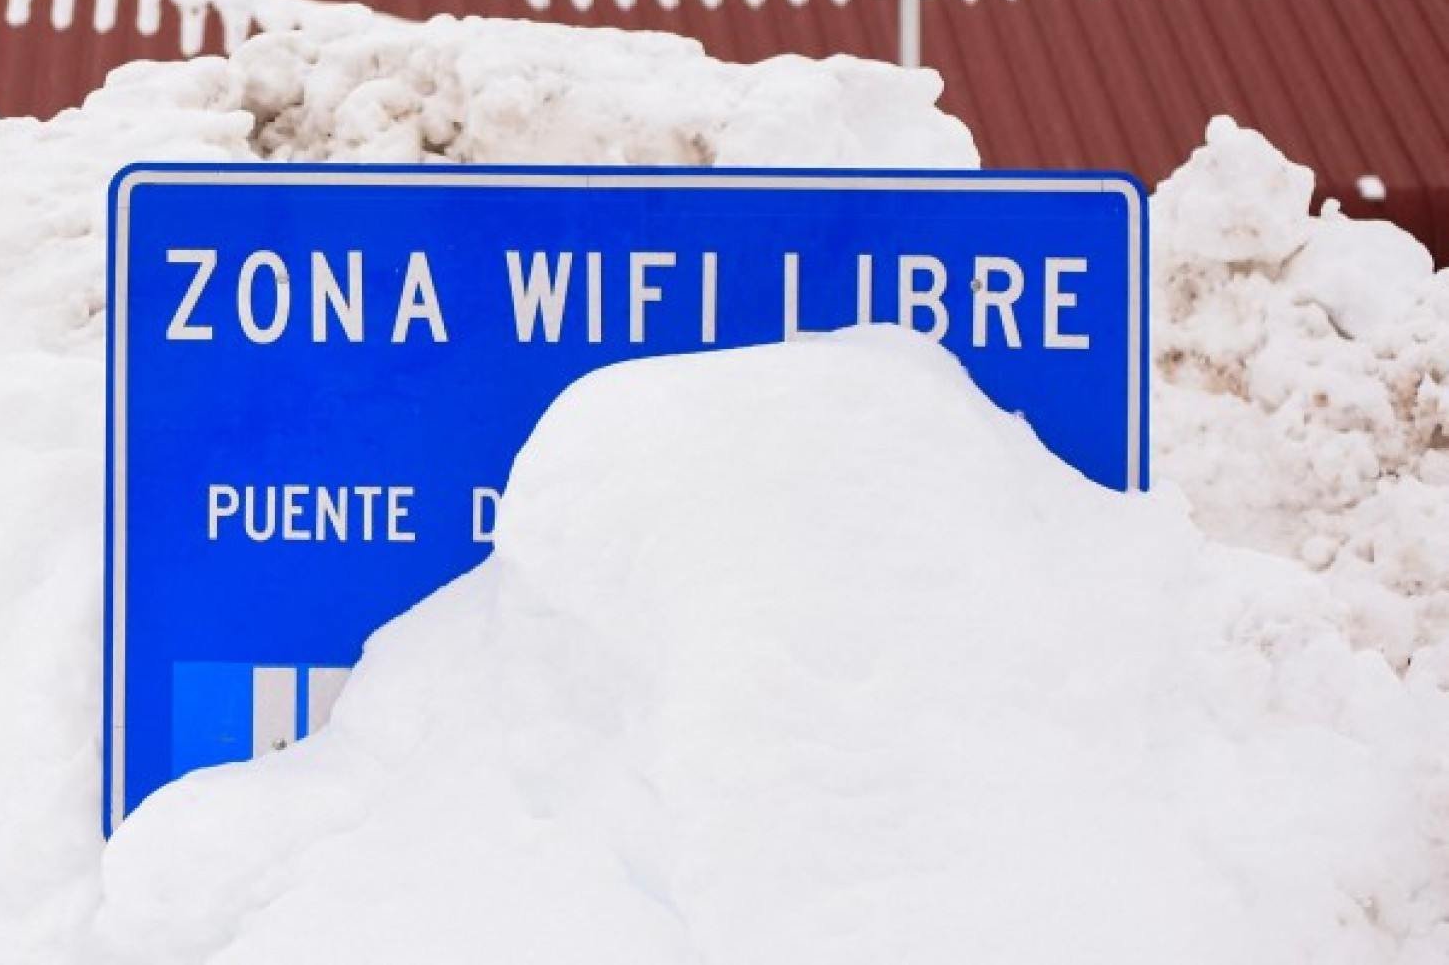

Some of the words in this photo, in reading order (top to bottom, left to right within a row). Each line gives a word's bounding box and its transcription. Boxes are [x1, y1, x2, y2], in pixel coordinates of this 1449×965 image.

[165, 249, 448, 345] ZONA
[506, 251, 719, 344] WIFI
[783, 251, 1091, 350] LIBRE
[208, 485, 417, 542] PUENTE
